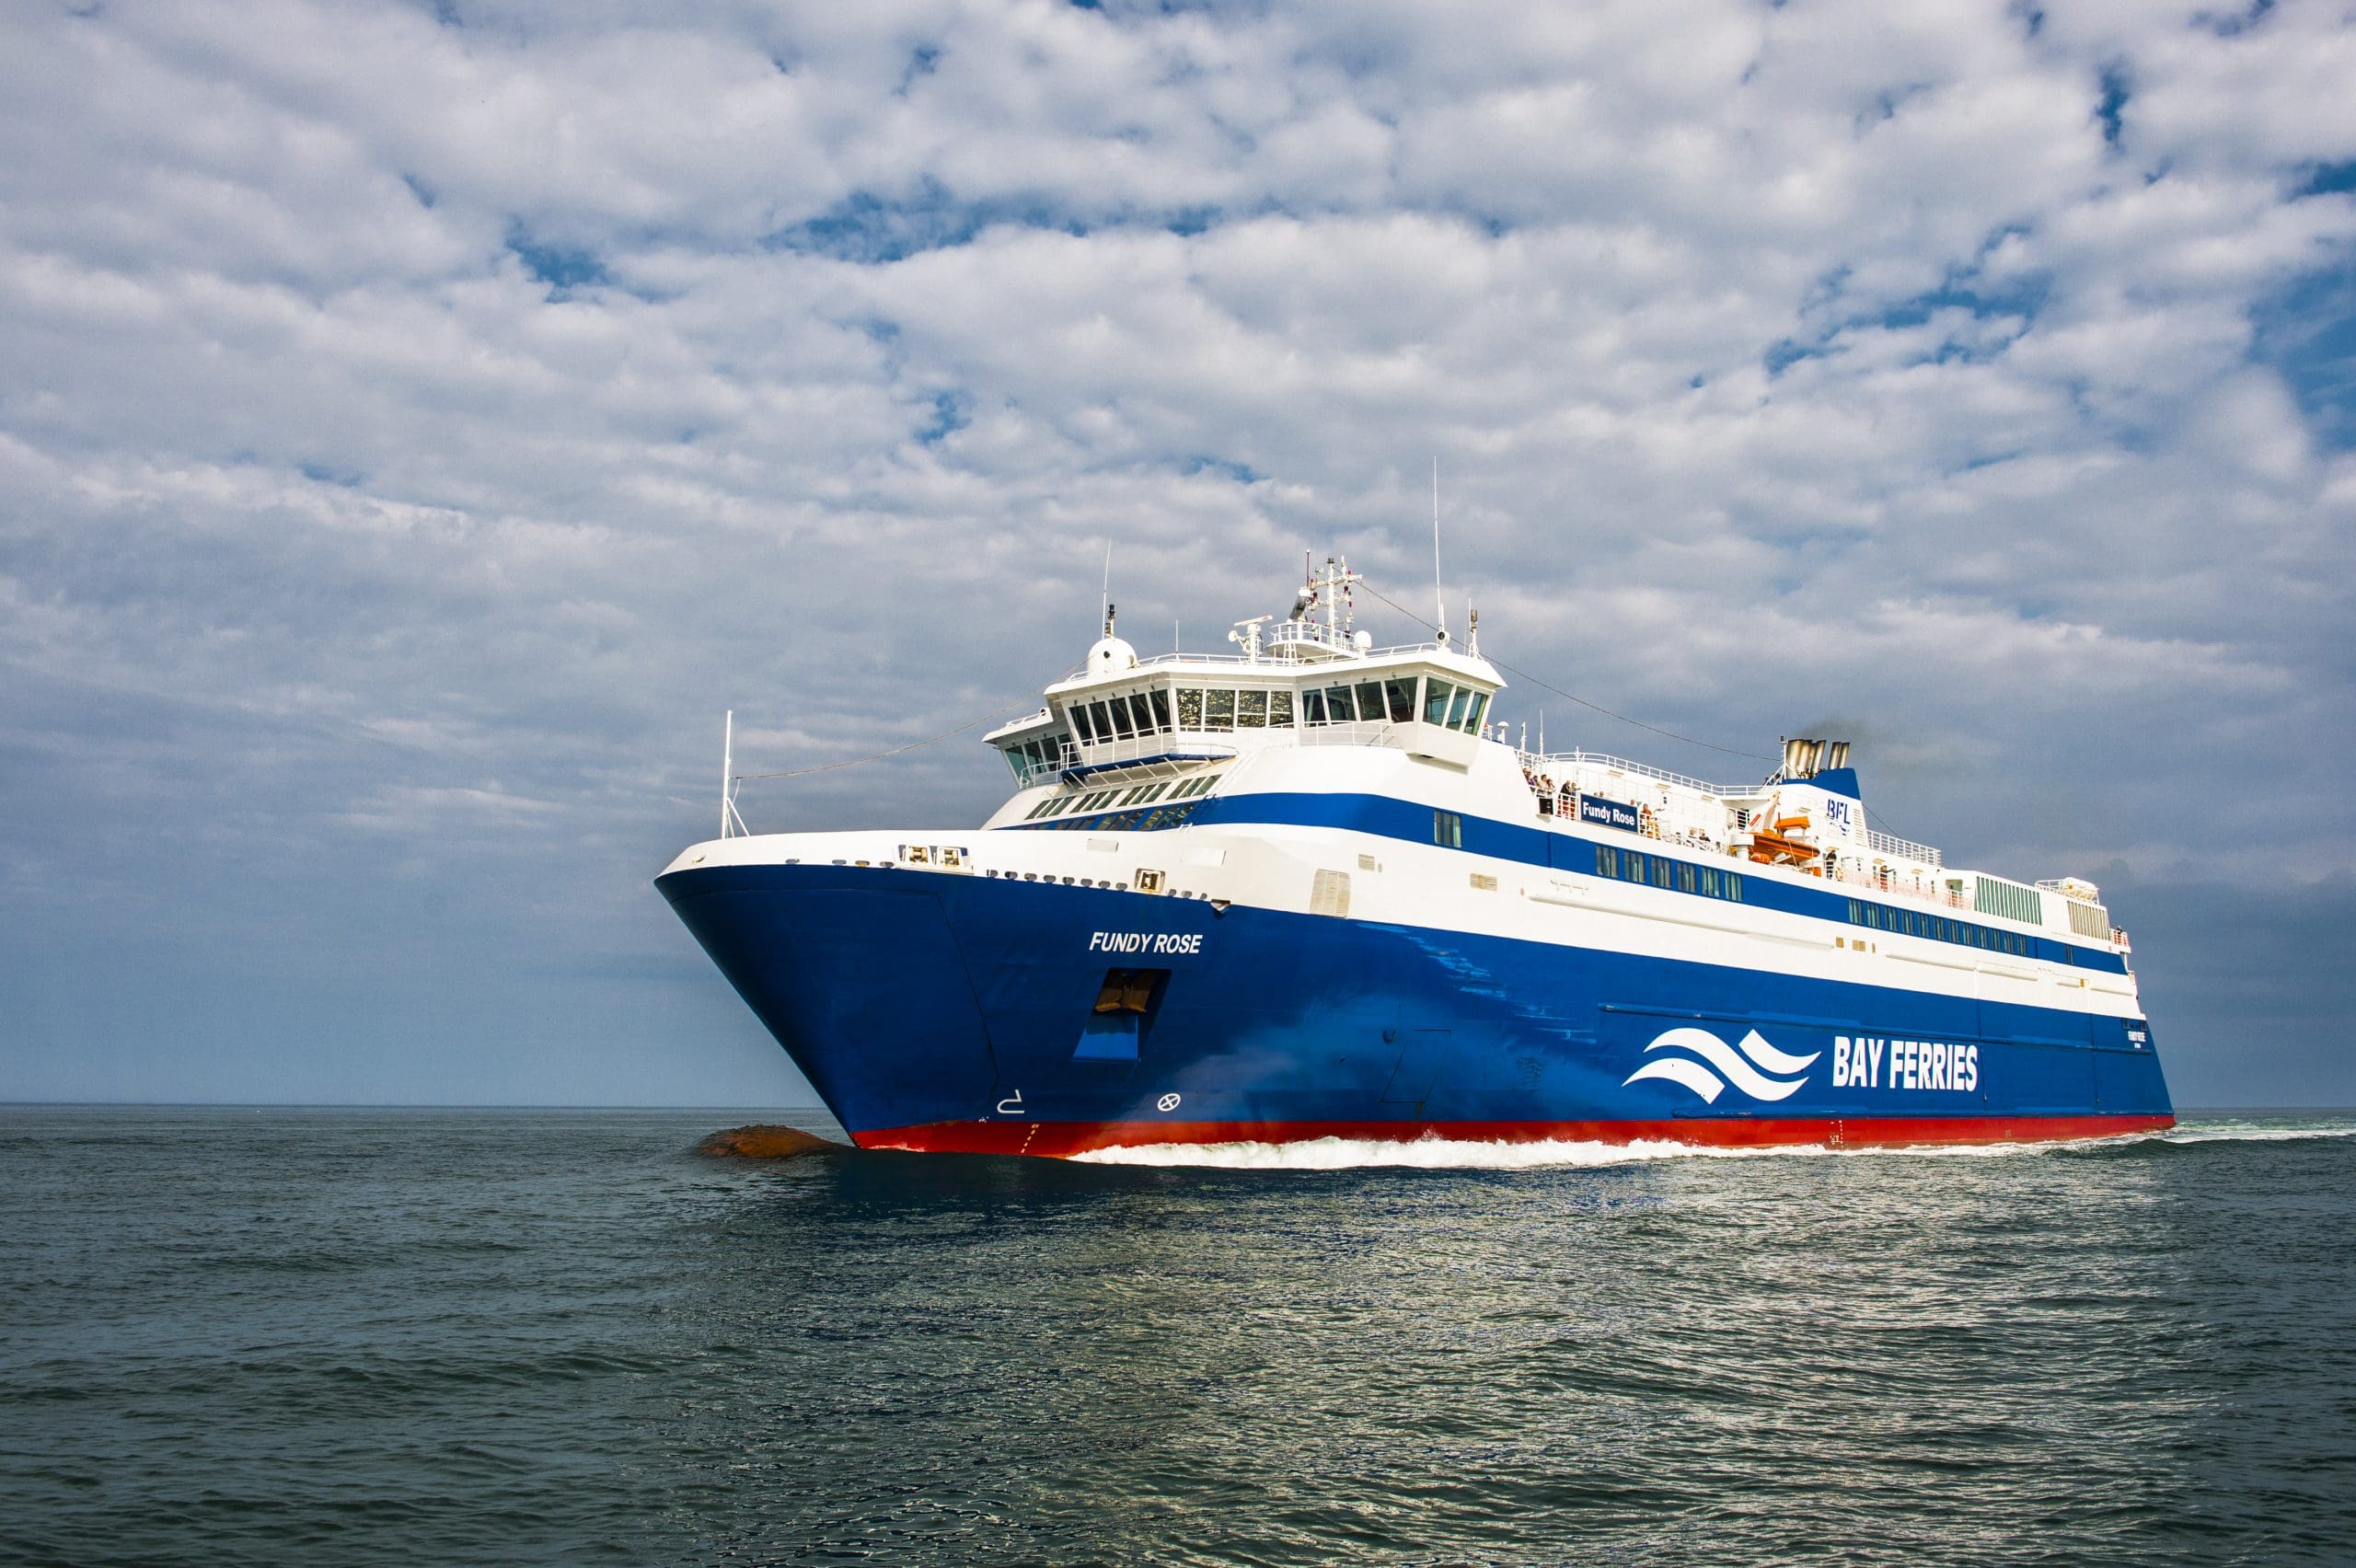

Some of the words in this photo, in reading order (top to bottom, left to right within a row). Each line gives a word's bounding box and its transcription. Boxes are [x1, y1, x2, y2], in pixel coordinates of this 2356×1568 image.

[1583, 801, 1611, 824] Fundy
[1612, 808, 1635, 826] Rose
[1827, 799, 1851, 824] BFL
[1089, 931, 1153, 953] FUNDY
[1153, 934, 1203, 954] ROSE
[1832, 1035, 1885, 1088] BAY
[1889, 1040, 1978, 1092] FERRIES
